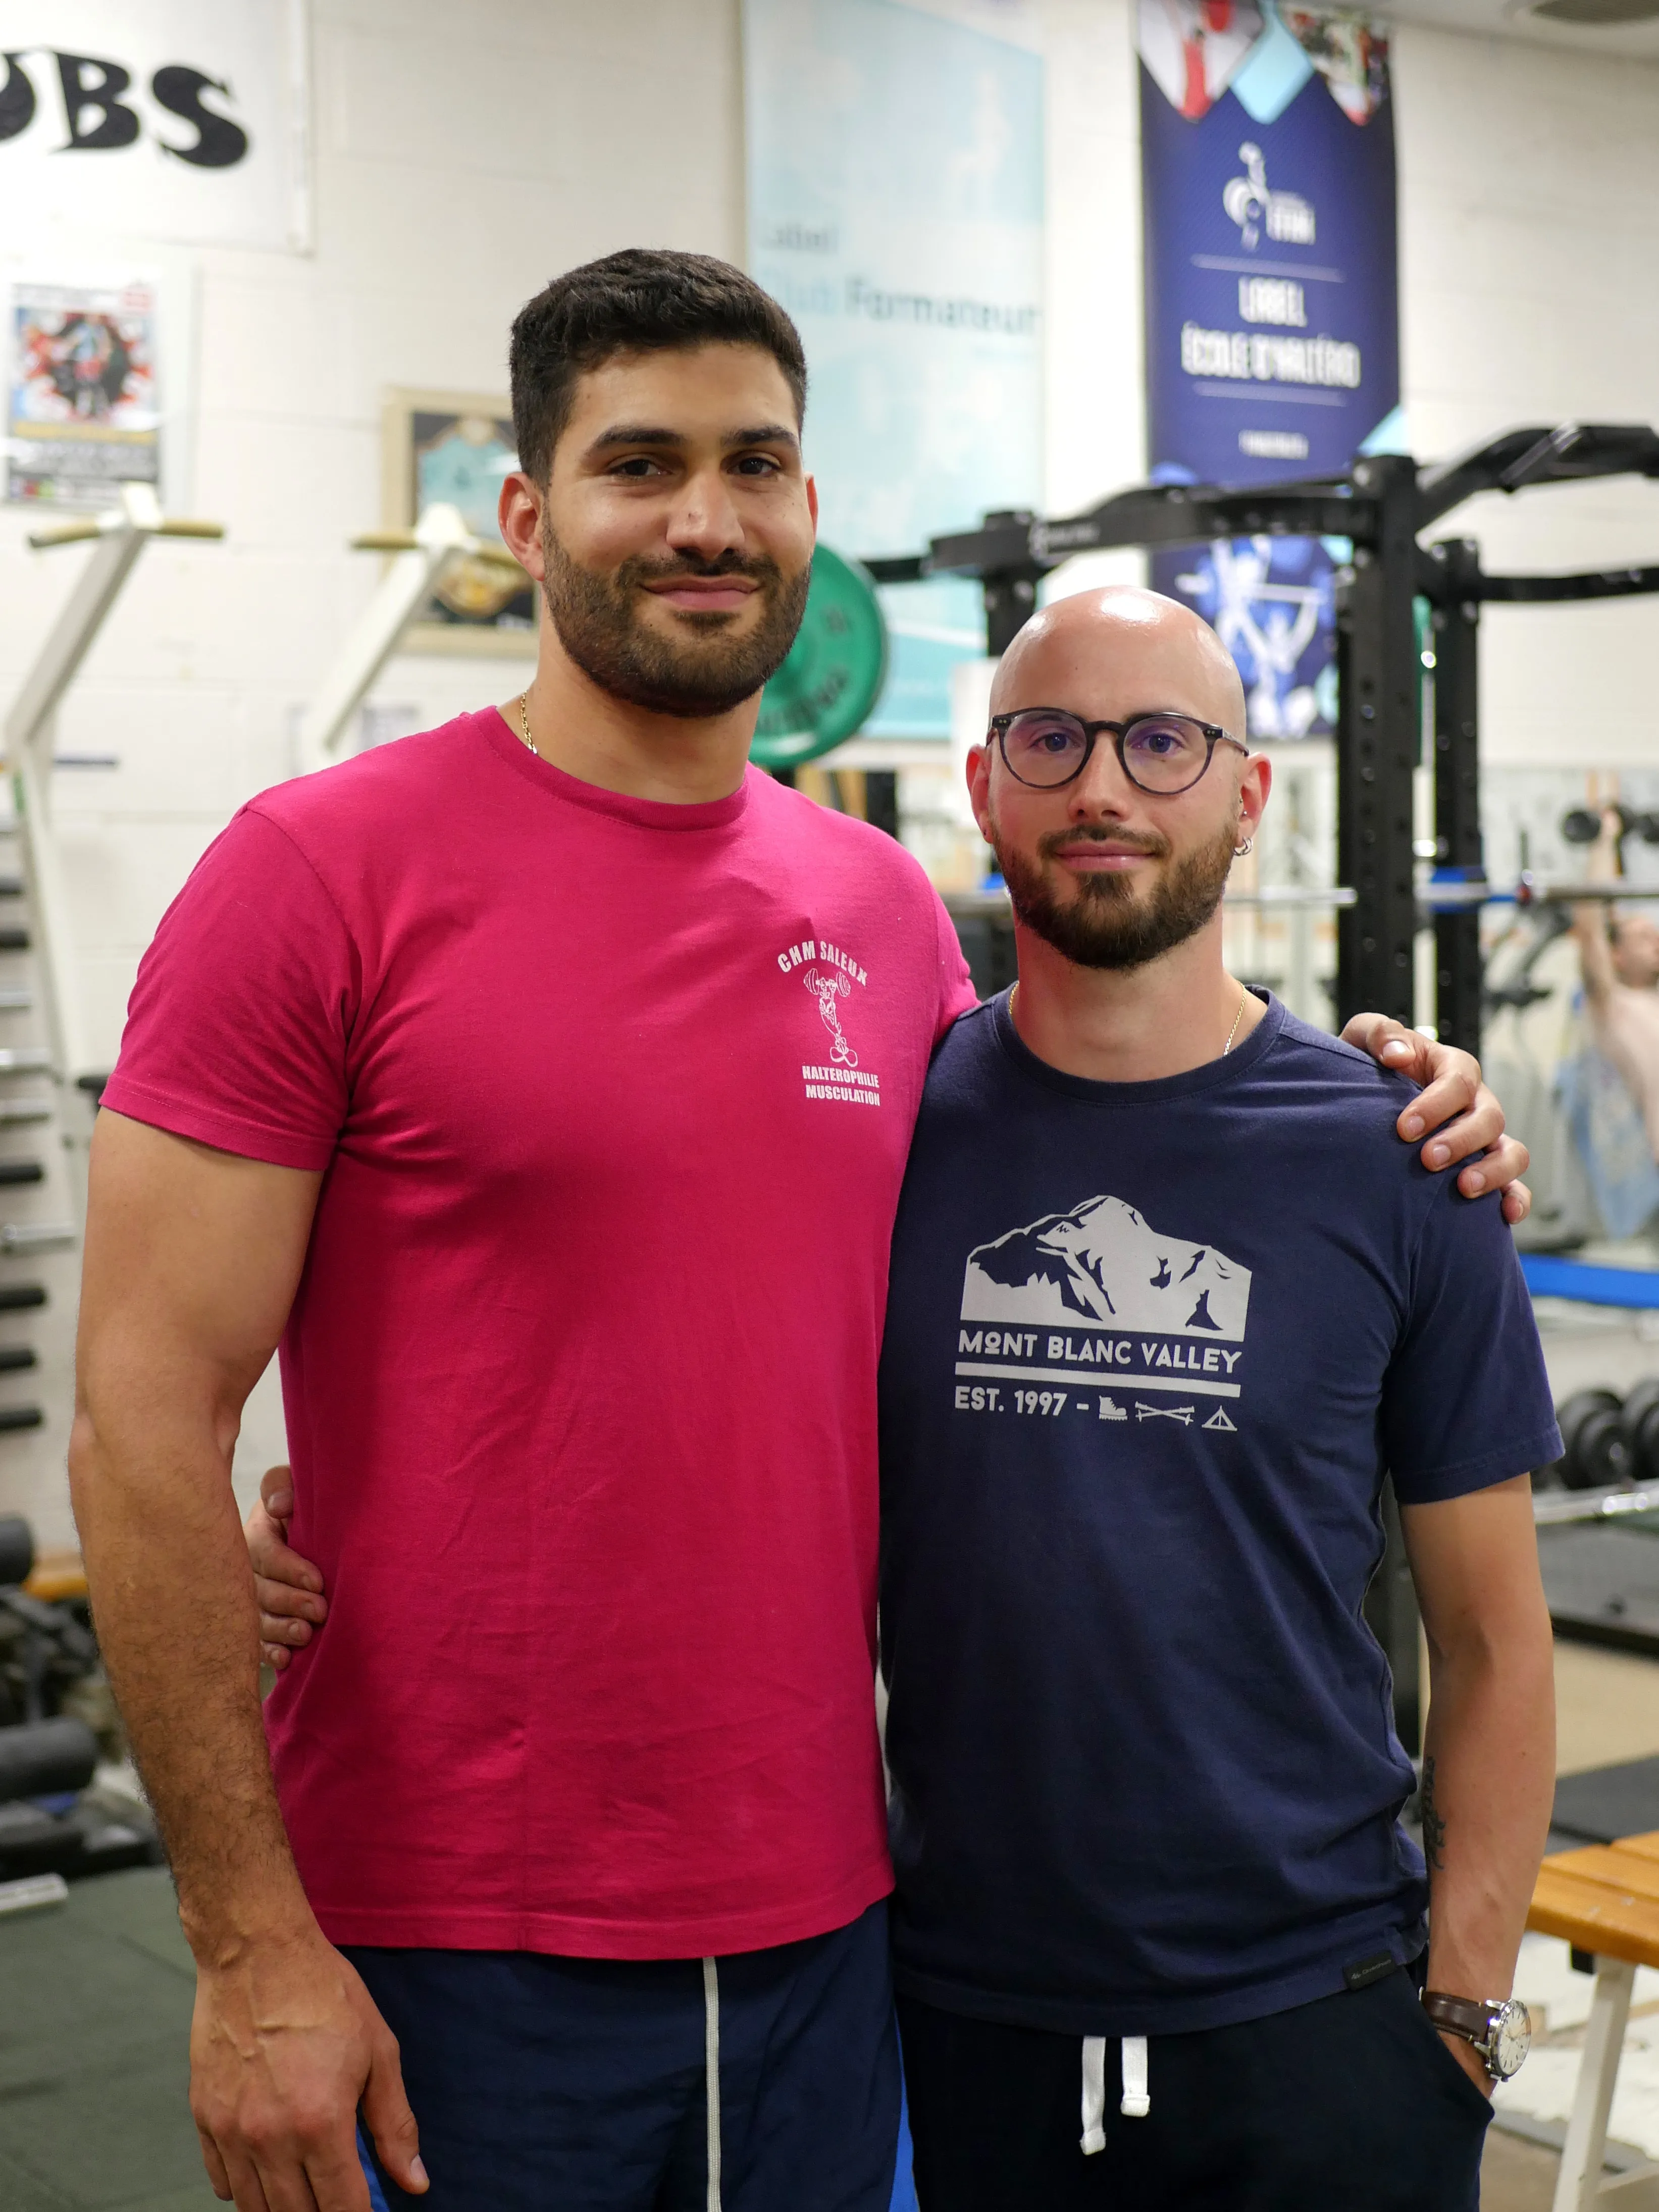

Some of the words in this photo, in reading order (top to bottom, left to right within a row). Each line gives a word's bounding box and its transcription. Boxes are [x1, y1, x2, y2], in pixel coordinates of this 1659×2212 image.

[777, 940, 816, 973] CHM
[819, 940, 868, 987] SALEUX
[802, 1065, 880, 1089] HALTEROPHILIE
[805, 1084, 880, 1107] MUSCULATION
[958, 1329, 1038, 1358] MONT
[1047, 1334, 1132, 1365] BLANC
[1140, 1342, 1243, 1374] VALLEY
[954, 1385, 1005, 1412] EST.
[1013, 1390, 1068, 1416] 1997
